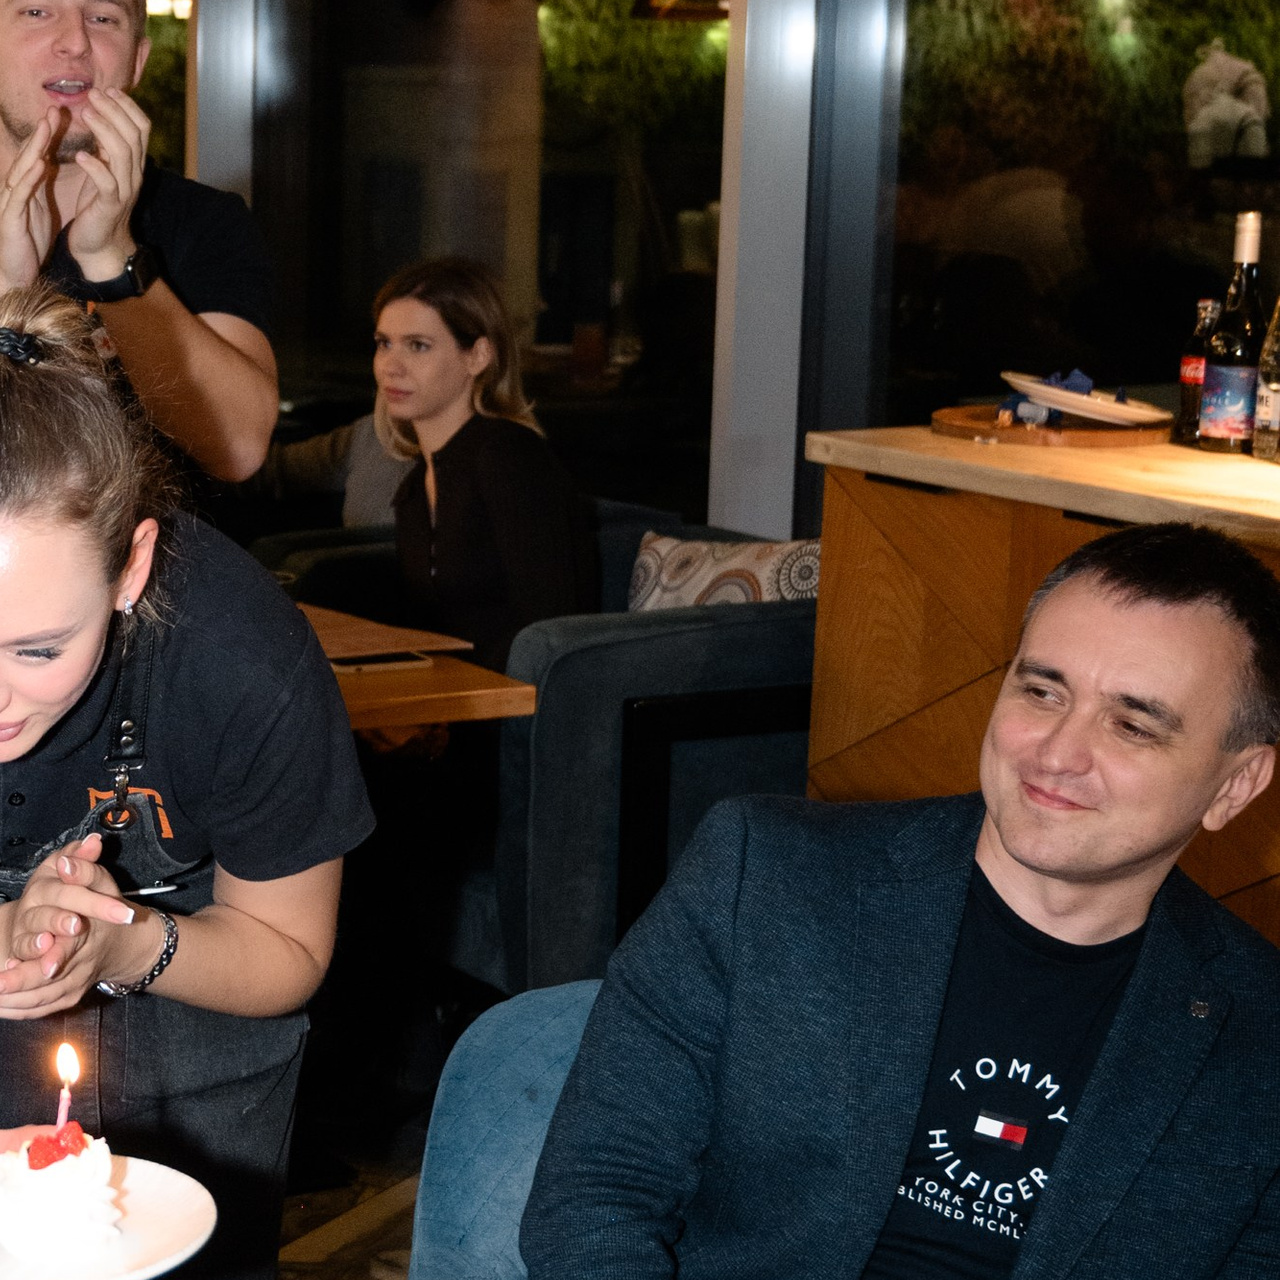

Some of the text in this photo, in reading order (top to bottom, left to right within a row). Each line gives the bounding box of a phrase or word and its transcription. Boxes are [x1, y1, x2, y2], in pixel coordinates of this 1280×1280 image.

[950, 1057, 1069, 1123] TOMMY
[914, 1176, 964, 1206] YORK
[928, 1129, 1049, 1203] HILFIGER
[897, 1185, 1027, 1239] BLISHED MCML
